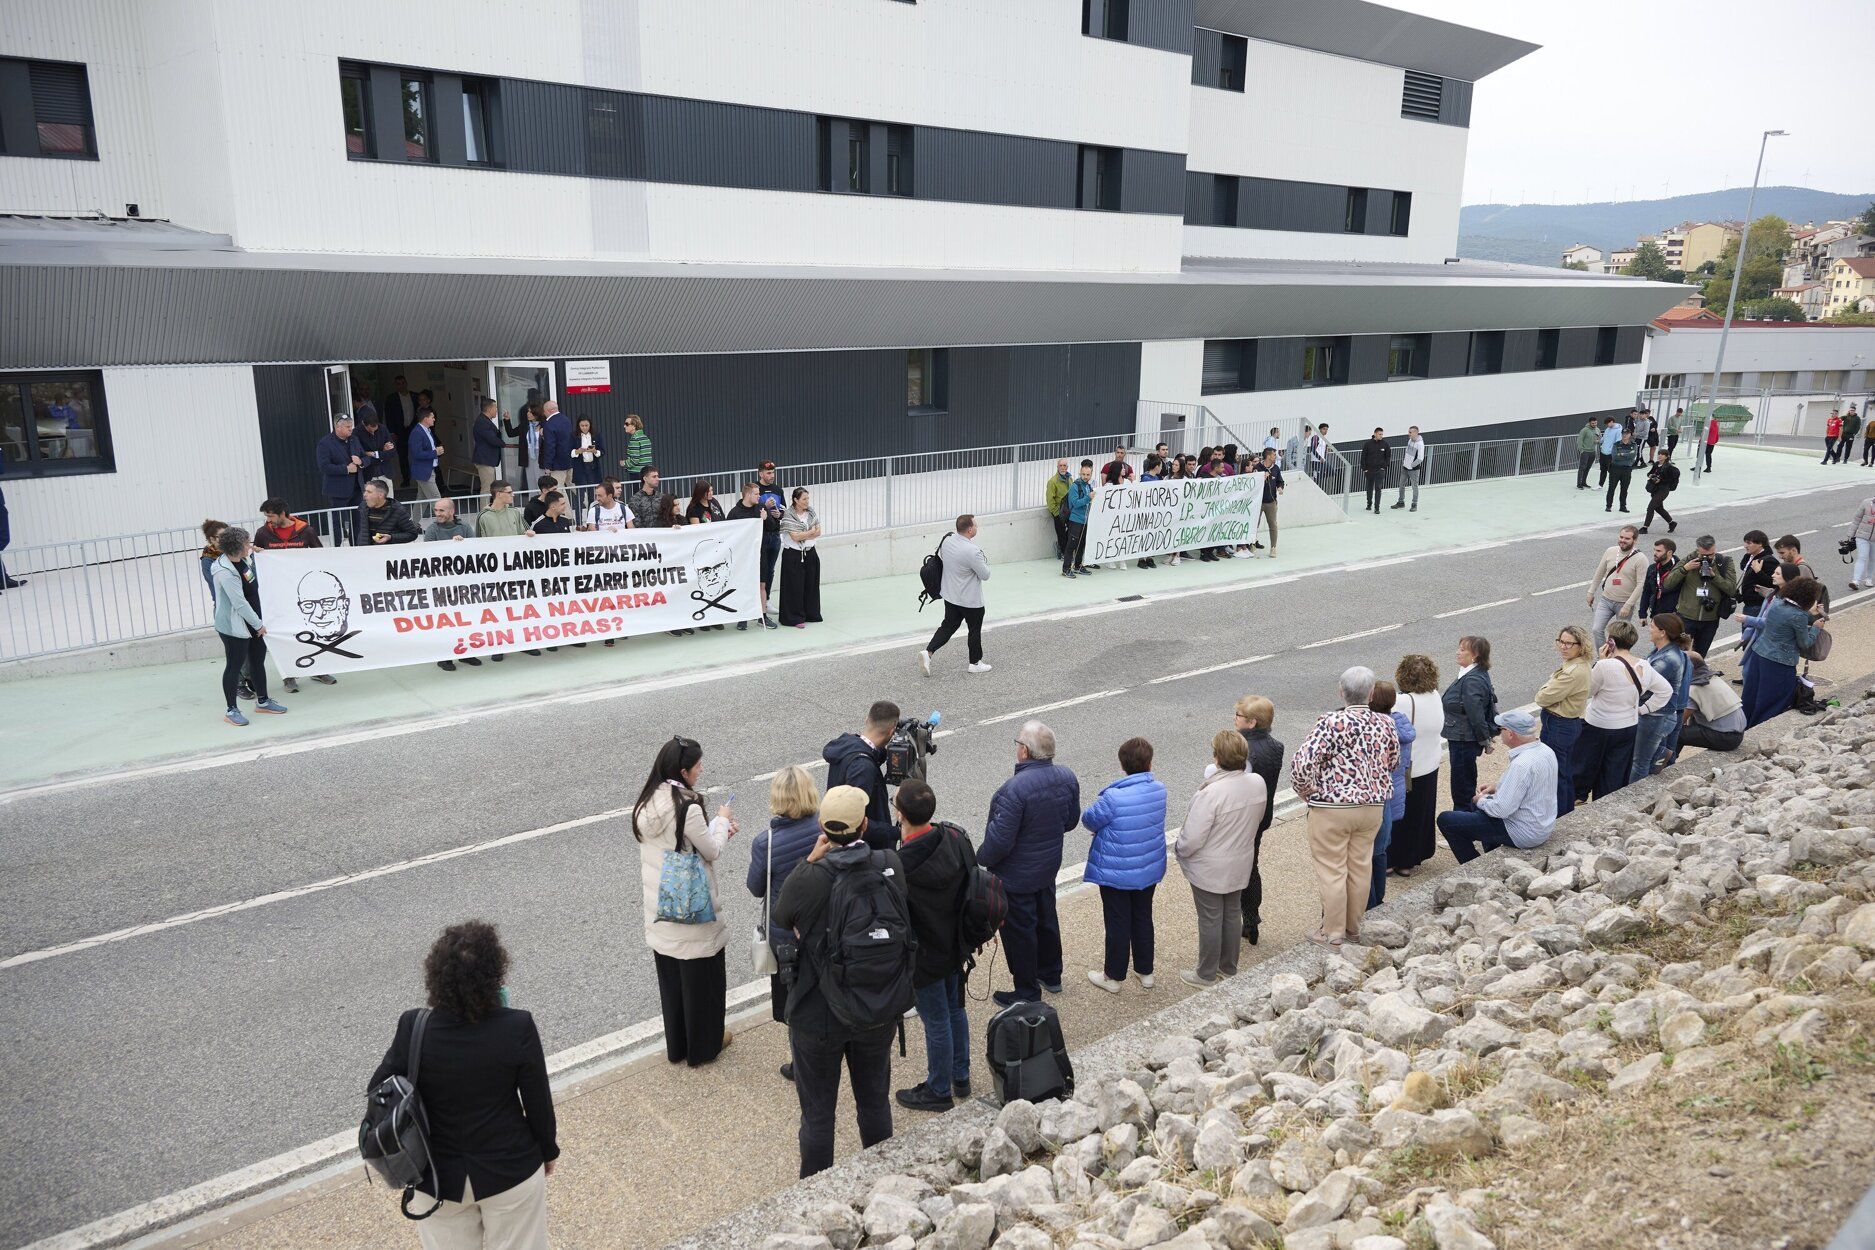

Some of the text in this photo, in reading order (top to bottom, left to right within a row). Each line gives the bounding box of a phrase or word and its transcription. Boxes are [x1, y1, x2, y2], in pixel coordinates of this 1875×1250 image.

[1102, 488, 1179, 513] FCT SIN HORAS
[1110, 512, 1172, 536] ALUMNADO
[386, 542, 662, 580] NAFARROAKO LANBIDE HEZIKETAN,
[1096, 530, 1171, 560] DESATENDIDO
[360, 588, 430, 614] BERTZE
[432, 579, 537, 608] MURRIZKETA
[541, 576, 570, 599] BAT
[632, 566, 688, 588] DIGUTE
[393, 591, 667, 633] DUAL A LA NAVARRA
[453, 616, 623, 655] ¿SIN HORAS?
